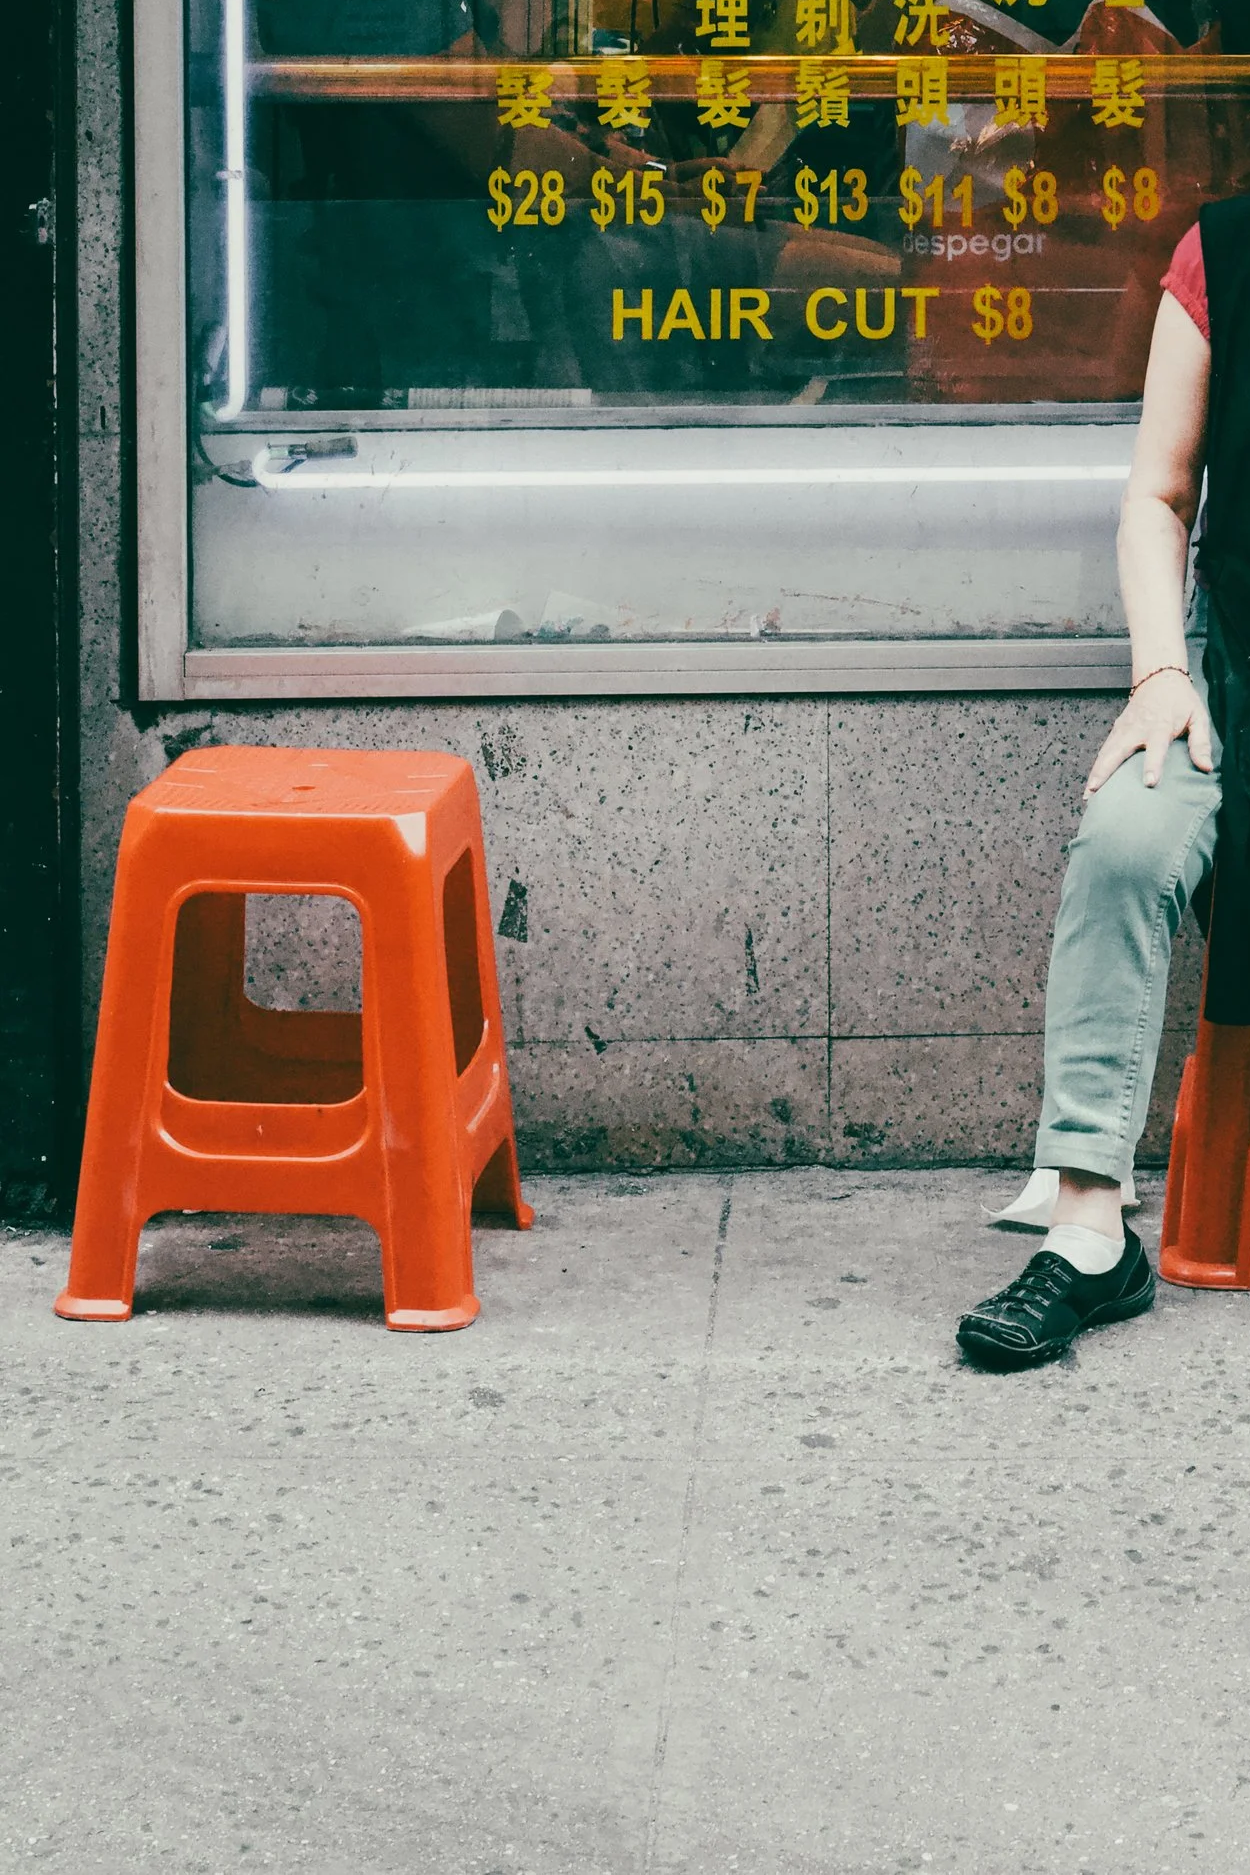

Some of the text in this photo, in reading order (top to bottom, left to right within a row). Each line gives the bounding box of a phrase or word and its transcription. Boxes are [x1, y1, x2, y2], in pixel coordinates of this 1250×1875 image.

[487, 168, 566, 233] $28
[590, 168, 666, 233] $15
[794, 168, 869, 232] $13
[898, 167, 974, 232] $11
[1002, 166, 1060, 231] $8
[1101, 165, 1163, 231] $8
[611, 284, 1034, 347] HAIR CUT $8
